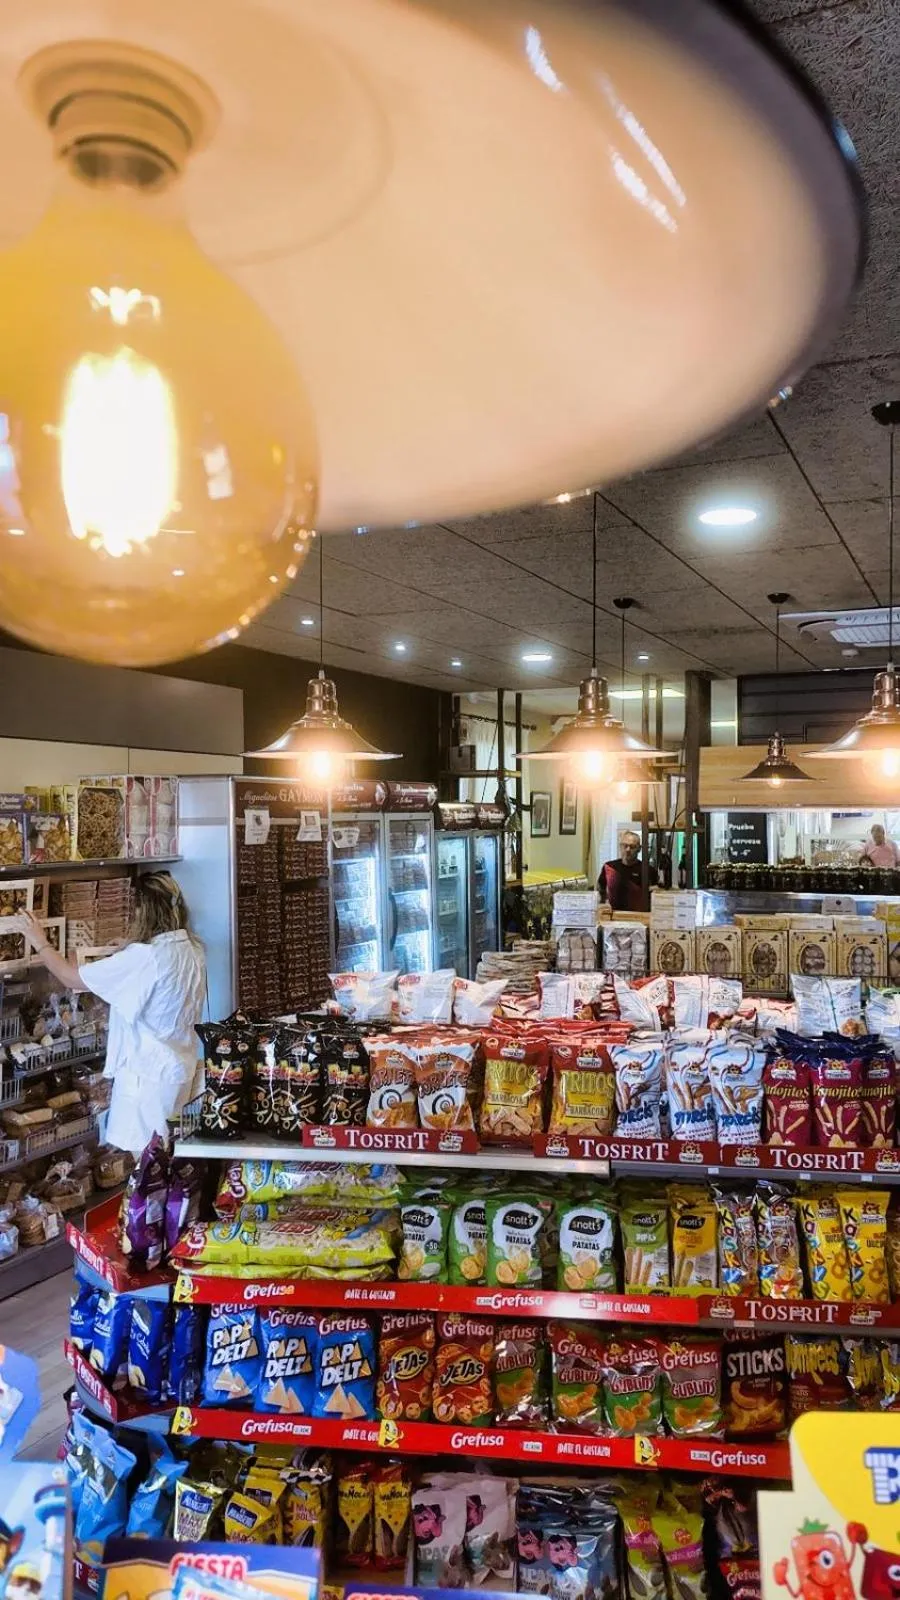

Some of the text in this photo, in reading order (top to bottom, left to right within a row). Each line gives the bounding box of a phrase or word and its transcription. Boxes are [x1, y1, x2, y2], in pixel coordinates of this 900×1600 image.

[345, 1129, 429, 1150] TOSFRIT
[578, 1139, 668, 1161] TOSFRIT
[770, 1149, 864, 1170] TOSFRIT
[505, 1234, 531, 1246] PATATAS
[572, 1240, 600, 1251] PATATAS
[244, 1284, 296, 1301] Grefusa
[491, 1294, 543, 1309] Grefusa
[319, 1317, 368, 1335] Grefus
[443, 1319, 494, 1338] Grefusa
[383, 1351, 429, 1384] JETAS
[727, 1347, 785, 1378] STICKS
[439, 1357, 486, 1388] JETAS
[241, 1418, 293, 1435] Grefusa
[451, 1432, 505, 1449] Grefusa
[711, 1450, 767, 1468] Grefusa
